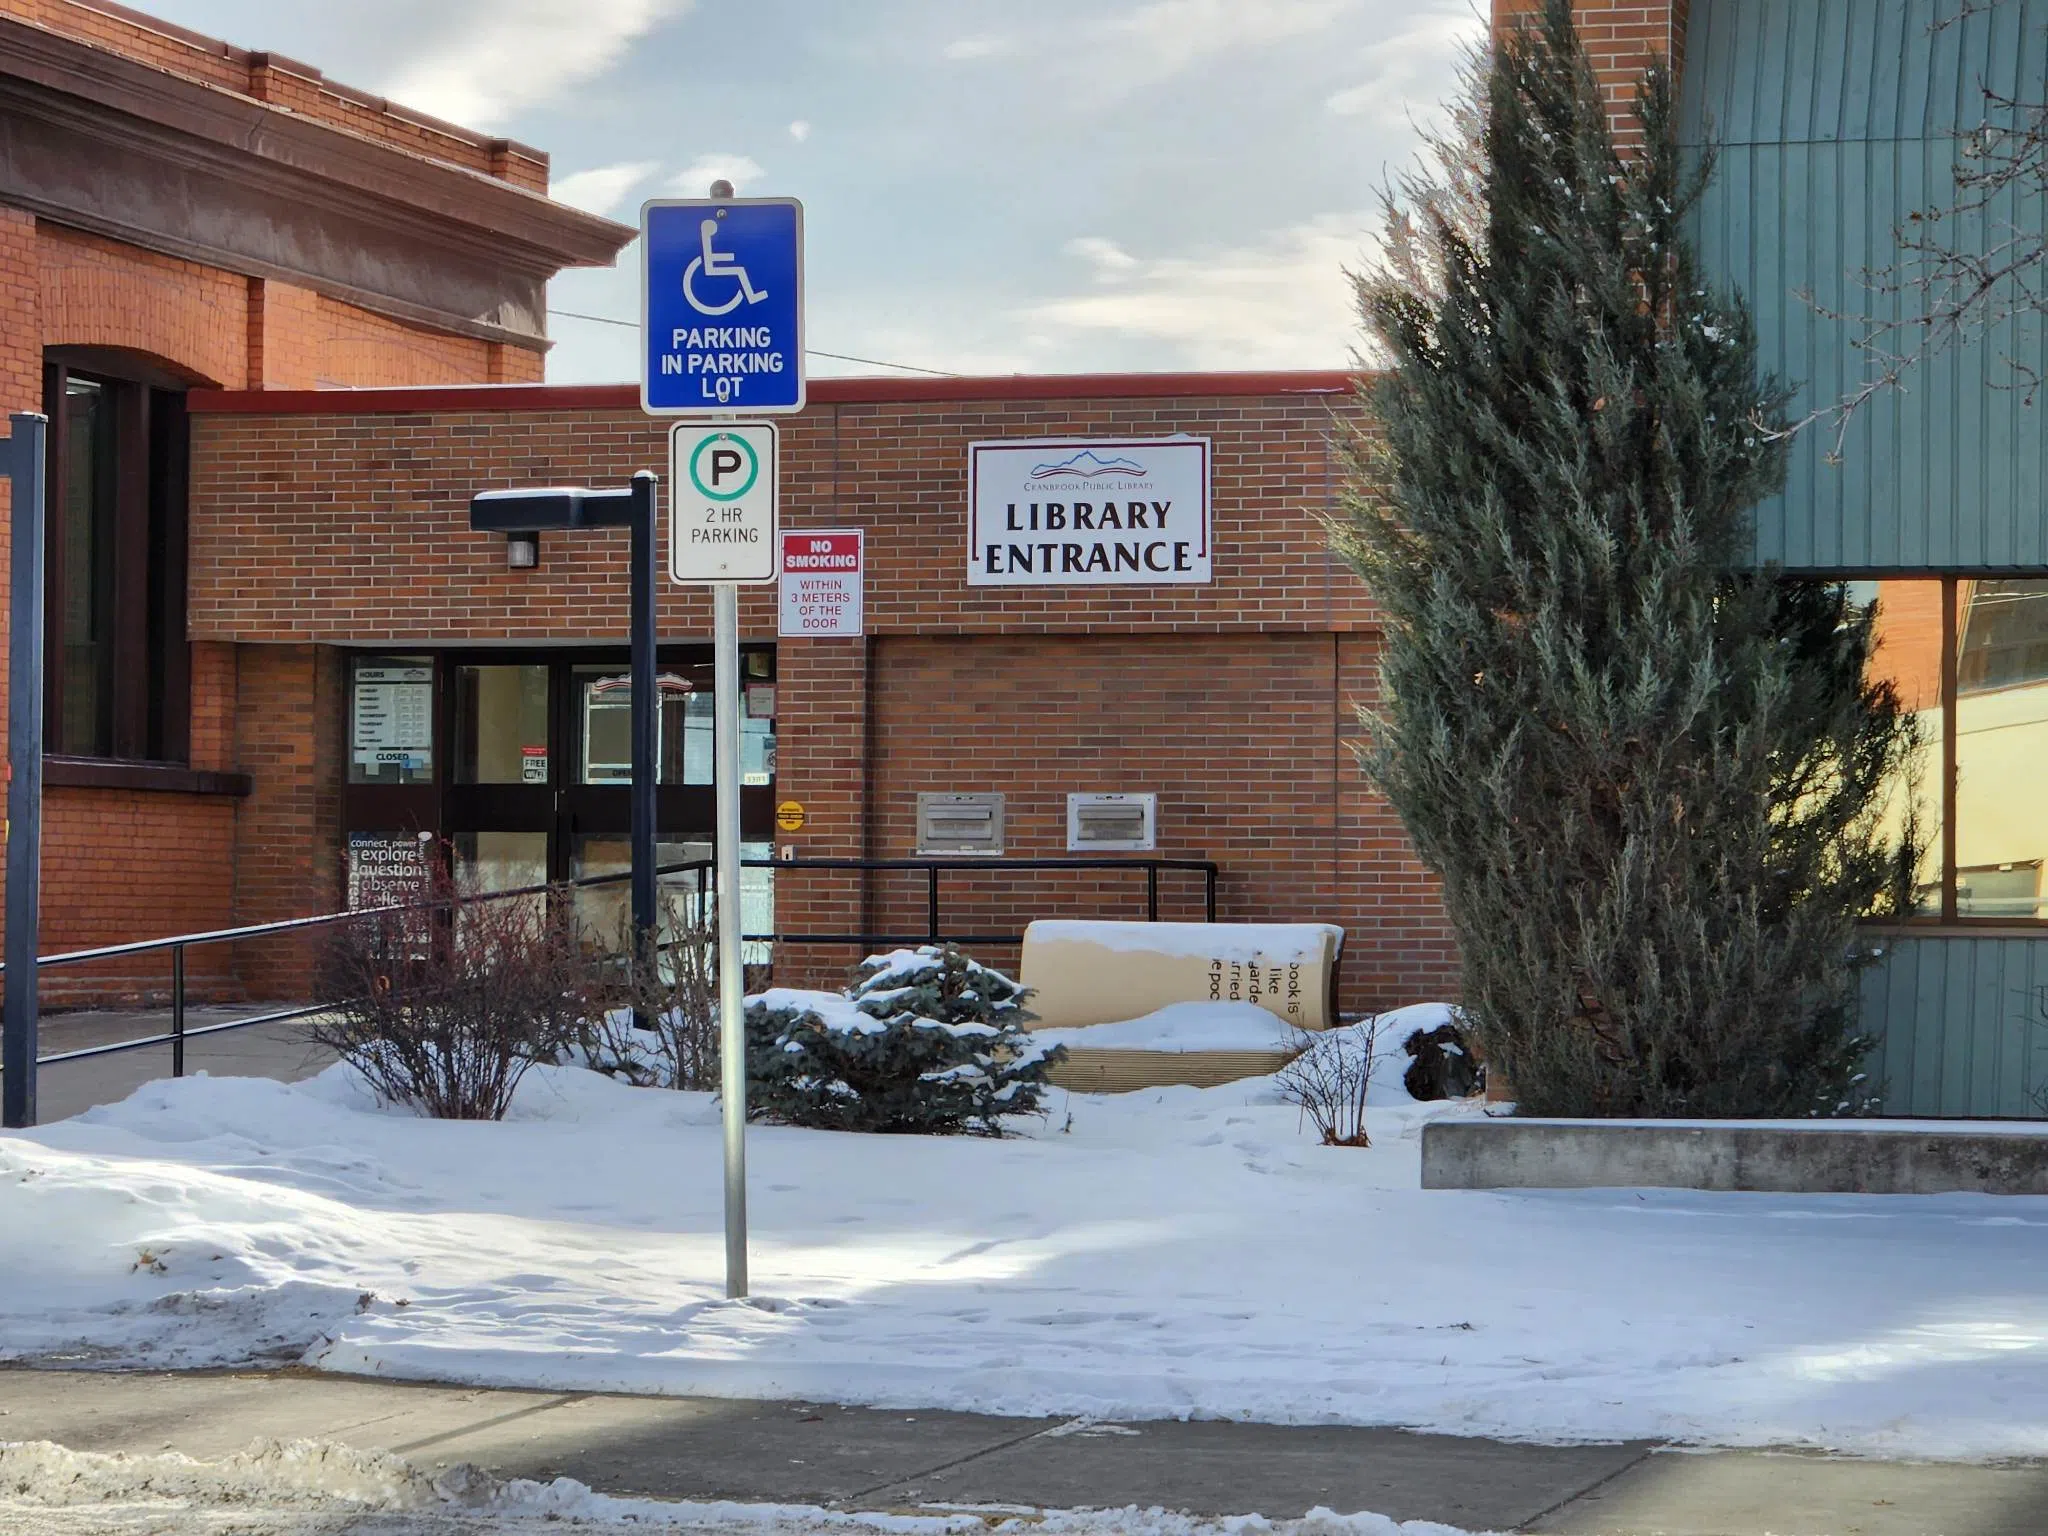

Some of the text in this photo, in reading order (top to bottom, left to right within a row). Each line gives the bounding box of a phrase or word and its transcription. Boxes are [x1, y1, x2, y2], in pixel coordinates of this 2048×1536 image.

[673, 327, 771, 349] PARKING
[661, 352, 784, 373] IN PARKING
[702, 377, 744, 398] LOT
[712, 450, 741, 486] P
[1082, 481, 1115, 491] PUBLIC
[1118, 481, 1154, 490] LIBRARY
[706, 508, 742, 523] 2 HR
[1007, 501, 1172, 531] LIBRARY
[692, 528, 759, 543] PARKING
[810, 540, 832, 553] NO
[786, 554, 856, 568] SMOKING
[985, 541, 1192, 574] ENTRANCE
[800, 580, 842, 590] WITHIN
[791, 592, 850, 603] 3 METERS
[799, 606, 842, 616] OF THE
[802, 618, 838, 629] DOOR
[351, 840, 388, 848] connect
[361, 846, 416, 864] explore
[359, 862, 422, 879] question
[361, 876, 420, 891] observe
[1208, 973, 1221, 1001] poc
[1269, 968, 1282, 994] like
[1288, 1002, 1300, 1014] is
